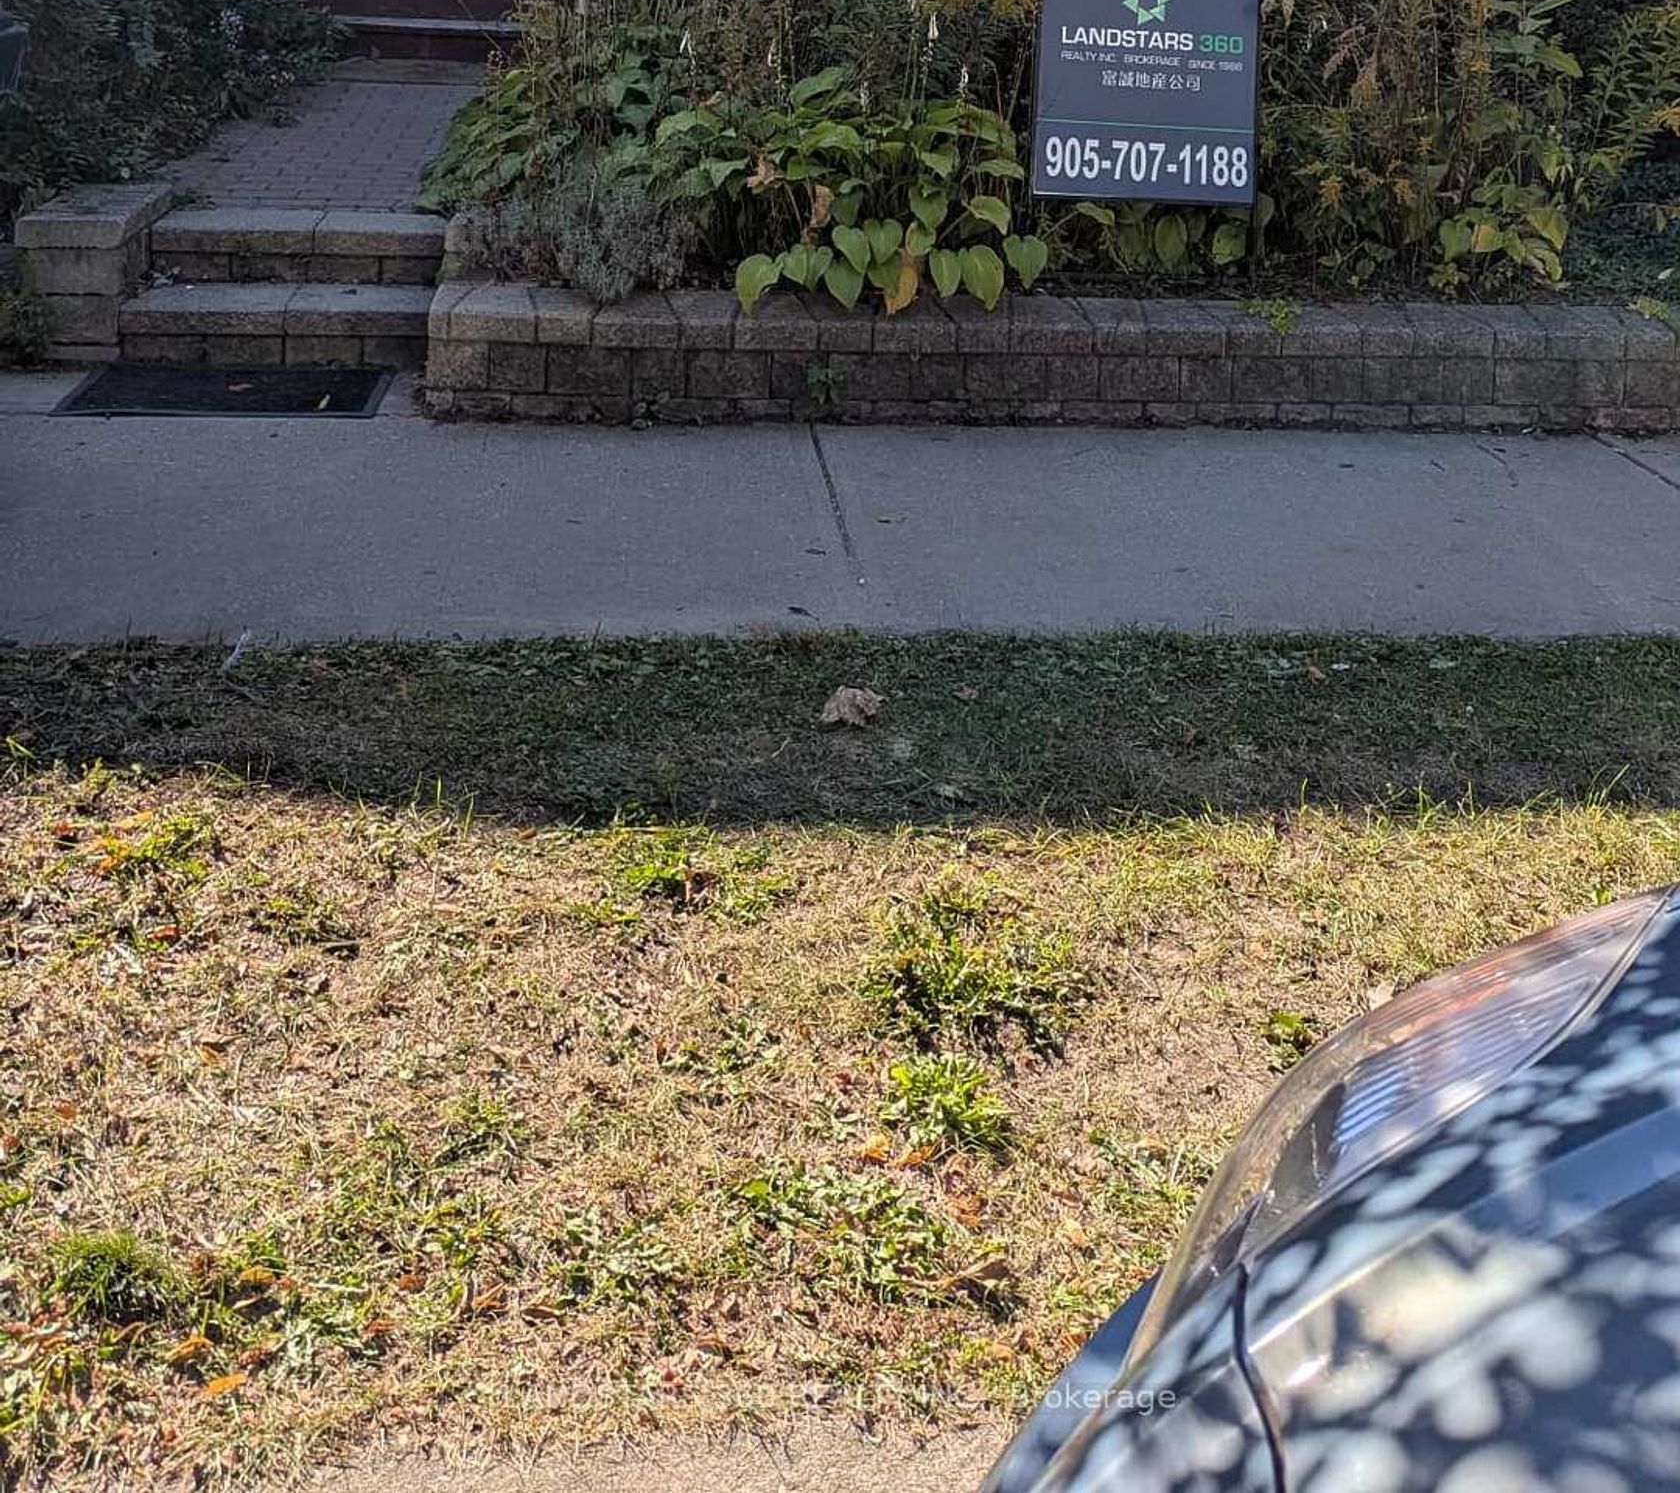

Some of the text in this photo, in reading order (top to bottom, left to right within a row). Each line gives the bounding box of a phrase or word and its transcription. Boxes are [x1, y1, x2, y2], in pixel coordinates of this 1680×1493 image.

[1062, 26, 1243, 54] LANDSTARS 360
[1061, 51, 1097, 62] REALTY
[1124, 55, 1181, 66] BROKERAGE
[1045, 136, 1248, 187] 905-707-1188
